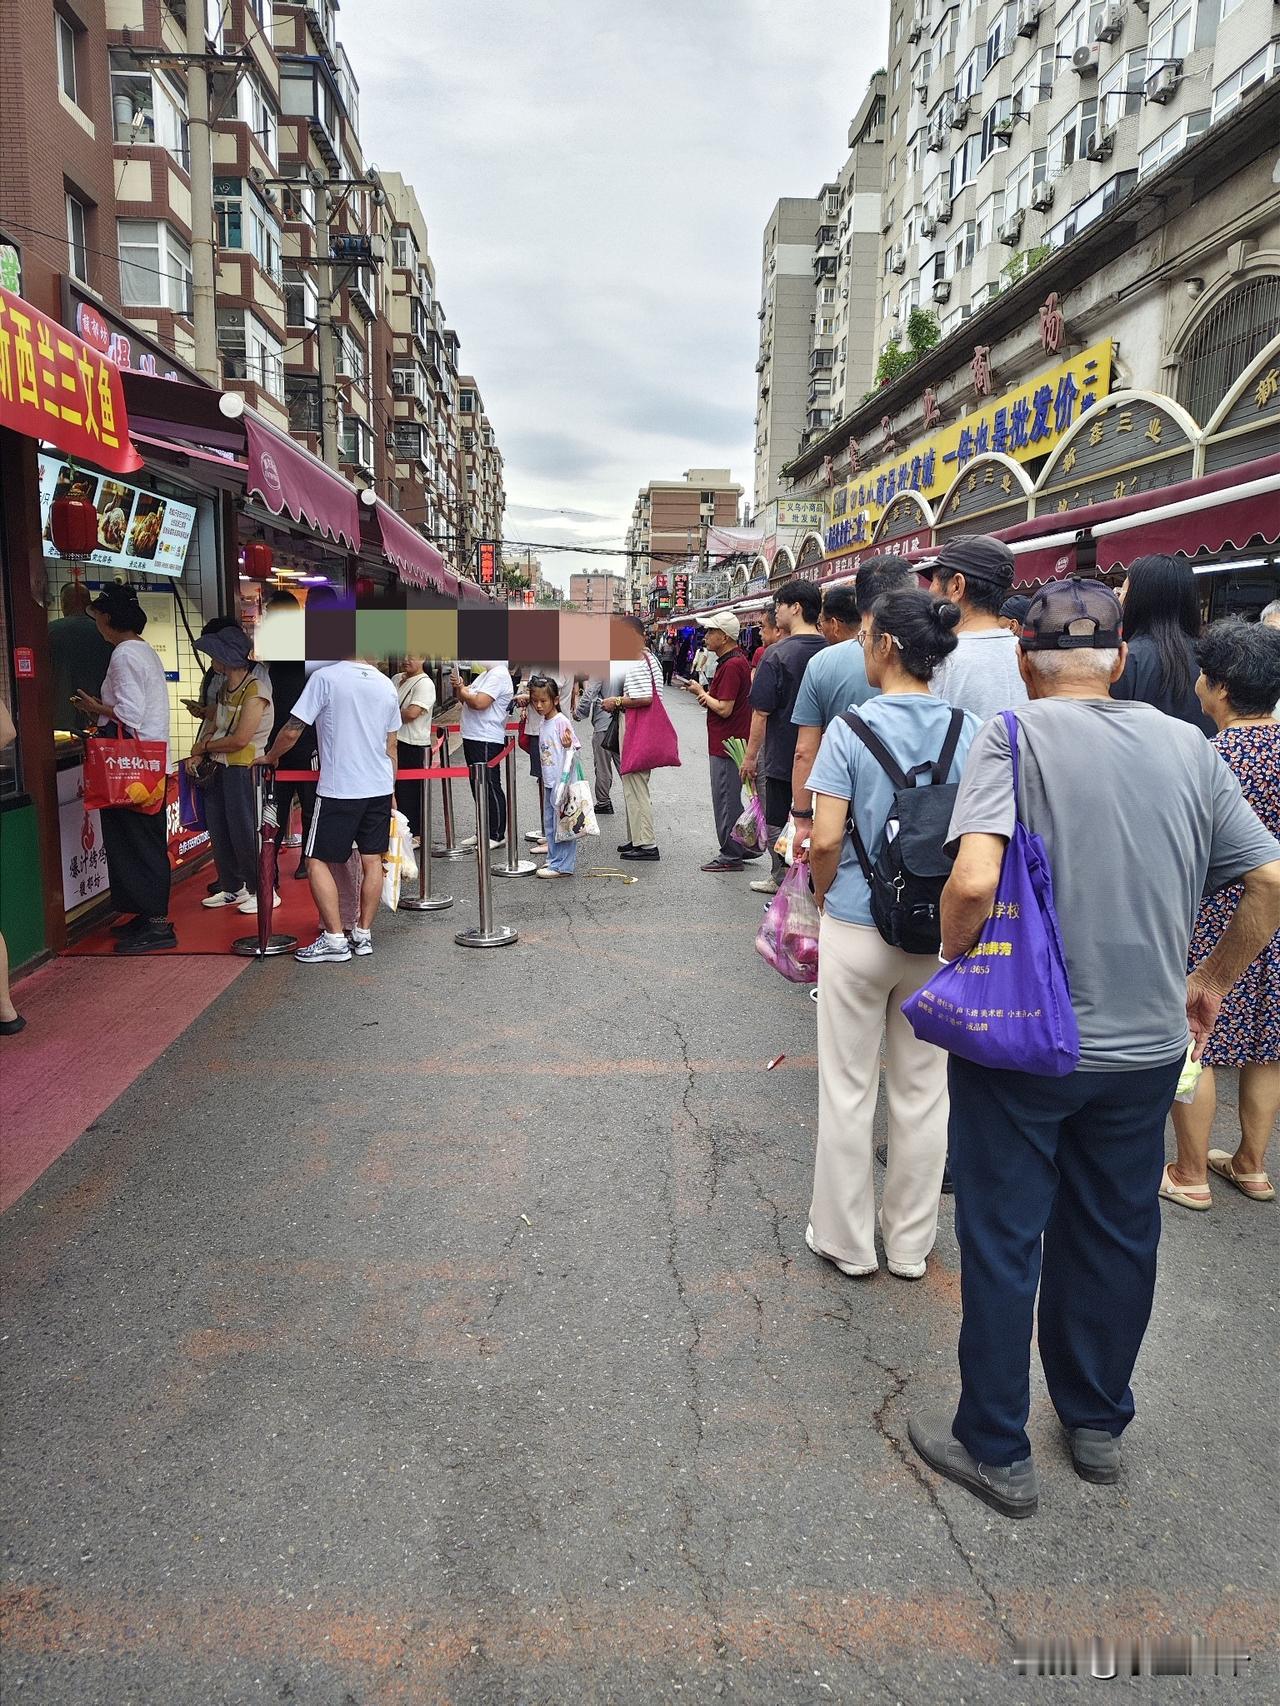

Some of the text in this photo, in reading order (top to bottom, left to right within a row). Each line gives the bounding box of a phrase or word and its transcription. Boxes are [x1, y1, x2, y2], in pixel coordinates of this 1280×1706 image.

[942, 372, 1079, 470] 一件也是批发价
[787, 503, 823, 512] 义乌小商品
[792, 513, 817, 523] 批发城
[988, 901, 1021, 919] 学校
